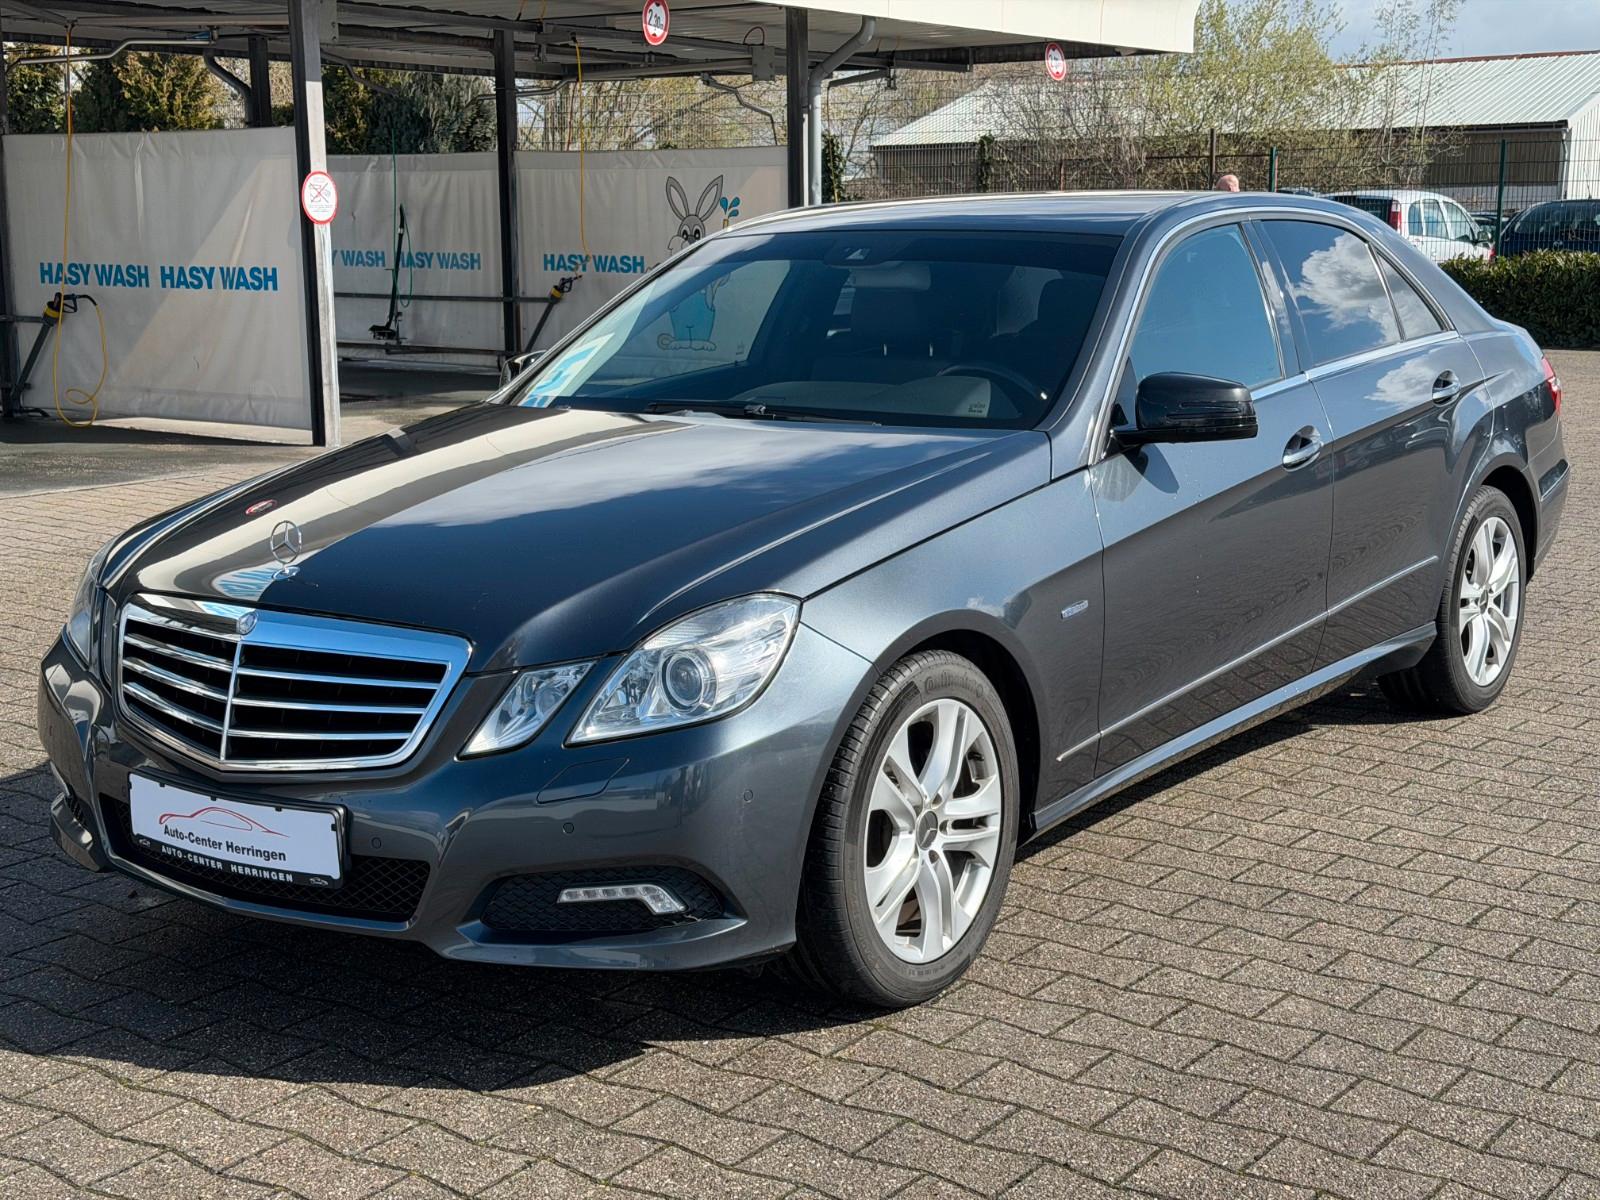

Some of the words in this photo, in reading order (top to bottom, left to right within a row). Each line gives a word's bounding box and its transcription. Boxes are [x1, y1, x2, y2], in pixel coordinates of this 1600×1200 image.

[341, 249, 386, 267] WASH
[436, 251, 481, 270] WASH
[543, 253, 591, 272] HASY
[592, 254, 645, 274] WASH
[39, 262, 91, 286] HASY
[93, 263, 150, 288] WASH
[159, 265, 215, 290] HASY
[218, 266, 279, 291] WASH
[164, 825, 223, 850] Auto-Center
[225, 840, 287, 862] Herringen
[161, 844, 223, 870] AUTO-CENTER
[230, 863, 294, 883] HERRINGEN
